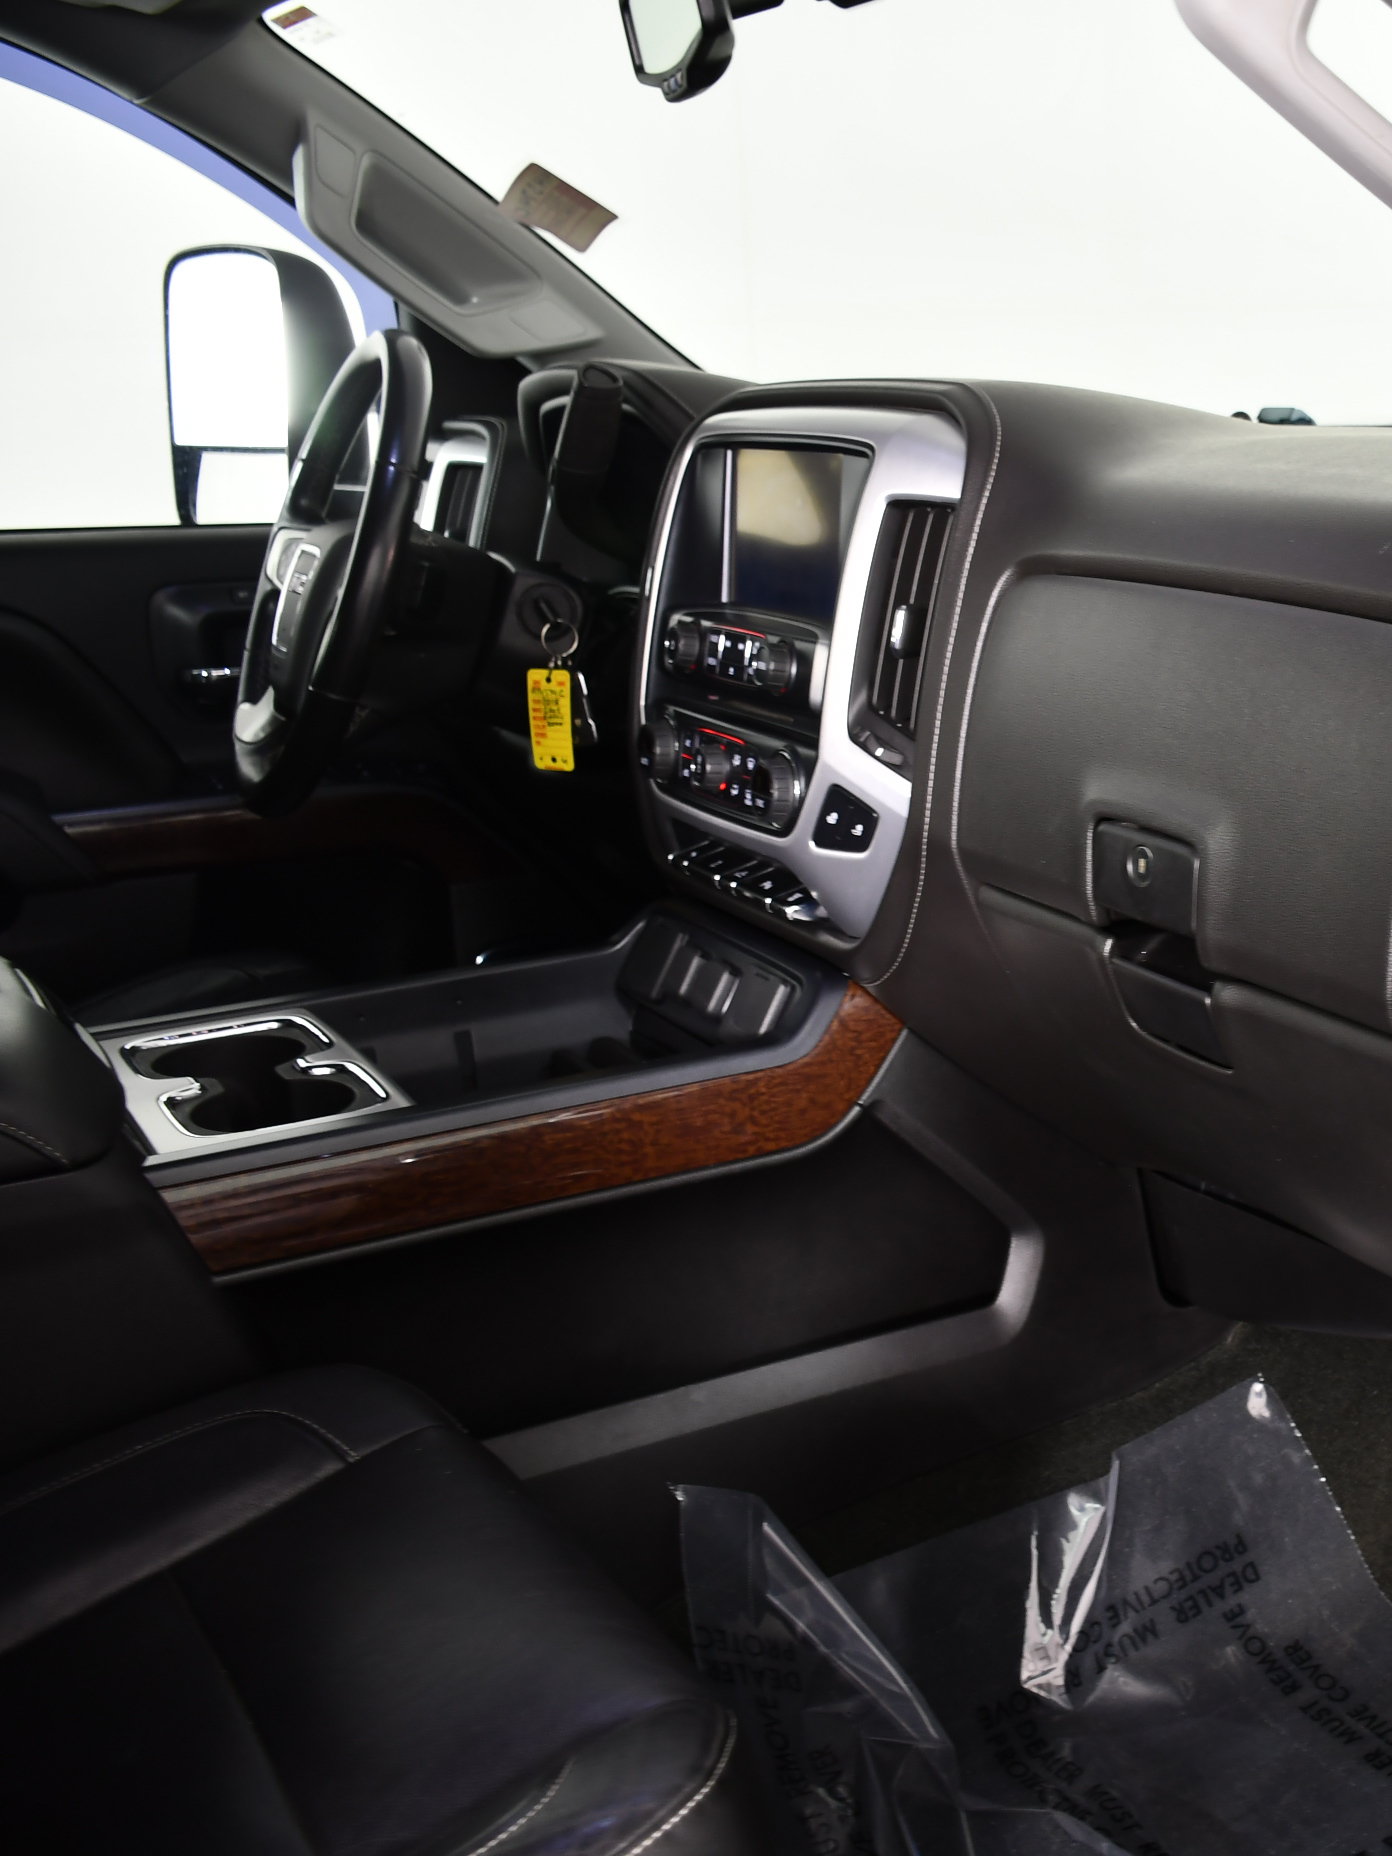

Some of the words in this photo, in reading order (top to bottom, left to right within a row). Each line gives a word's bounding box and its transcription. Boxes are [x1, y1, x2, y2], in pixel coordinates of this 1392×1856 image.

[1104, 1534, 1249, 1629] PROTECTIVE
[1170, 1560, 1261, 1625] DEALER
[1091, 1617, 1160, 1676] MUST
[1222, 1603, 1303, 1696] REMOVE
[1284, 1640, 1350, 1702] COVER
[1299, 1700, 1363, 1745] MUST
[1013, 1718, 1084, 1786] DEALER
[1085, 1783, 1145, 1832] MUST
